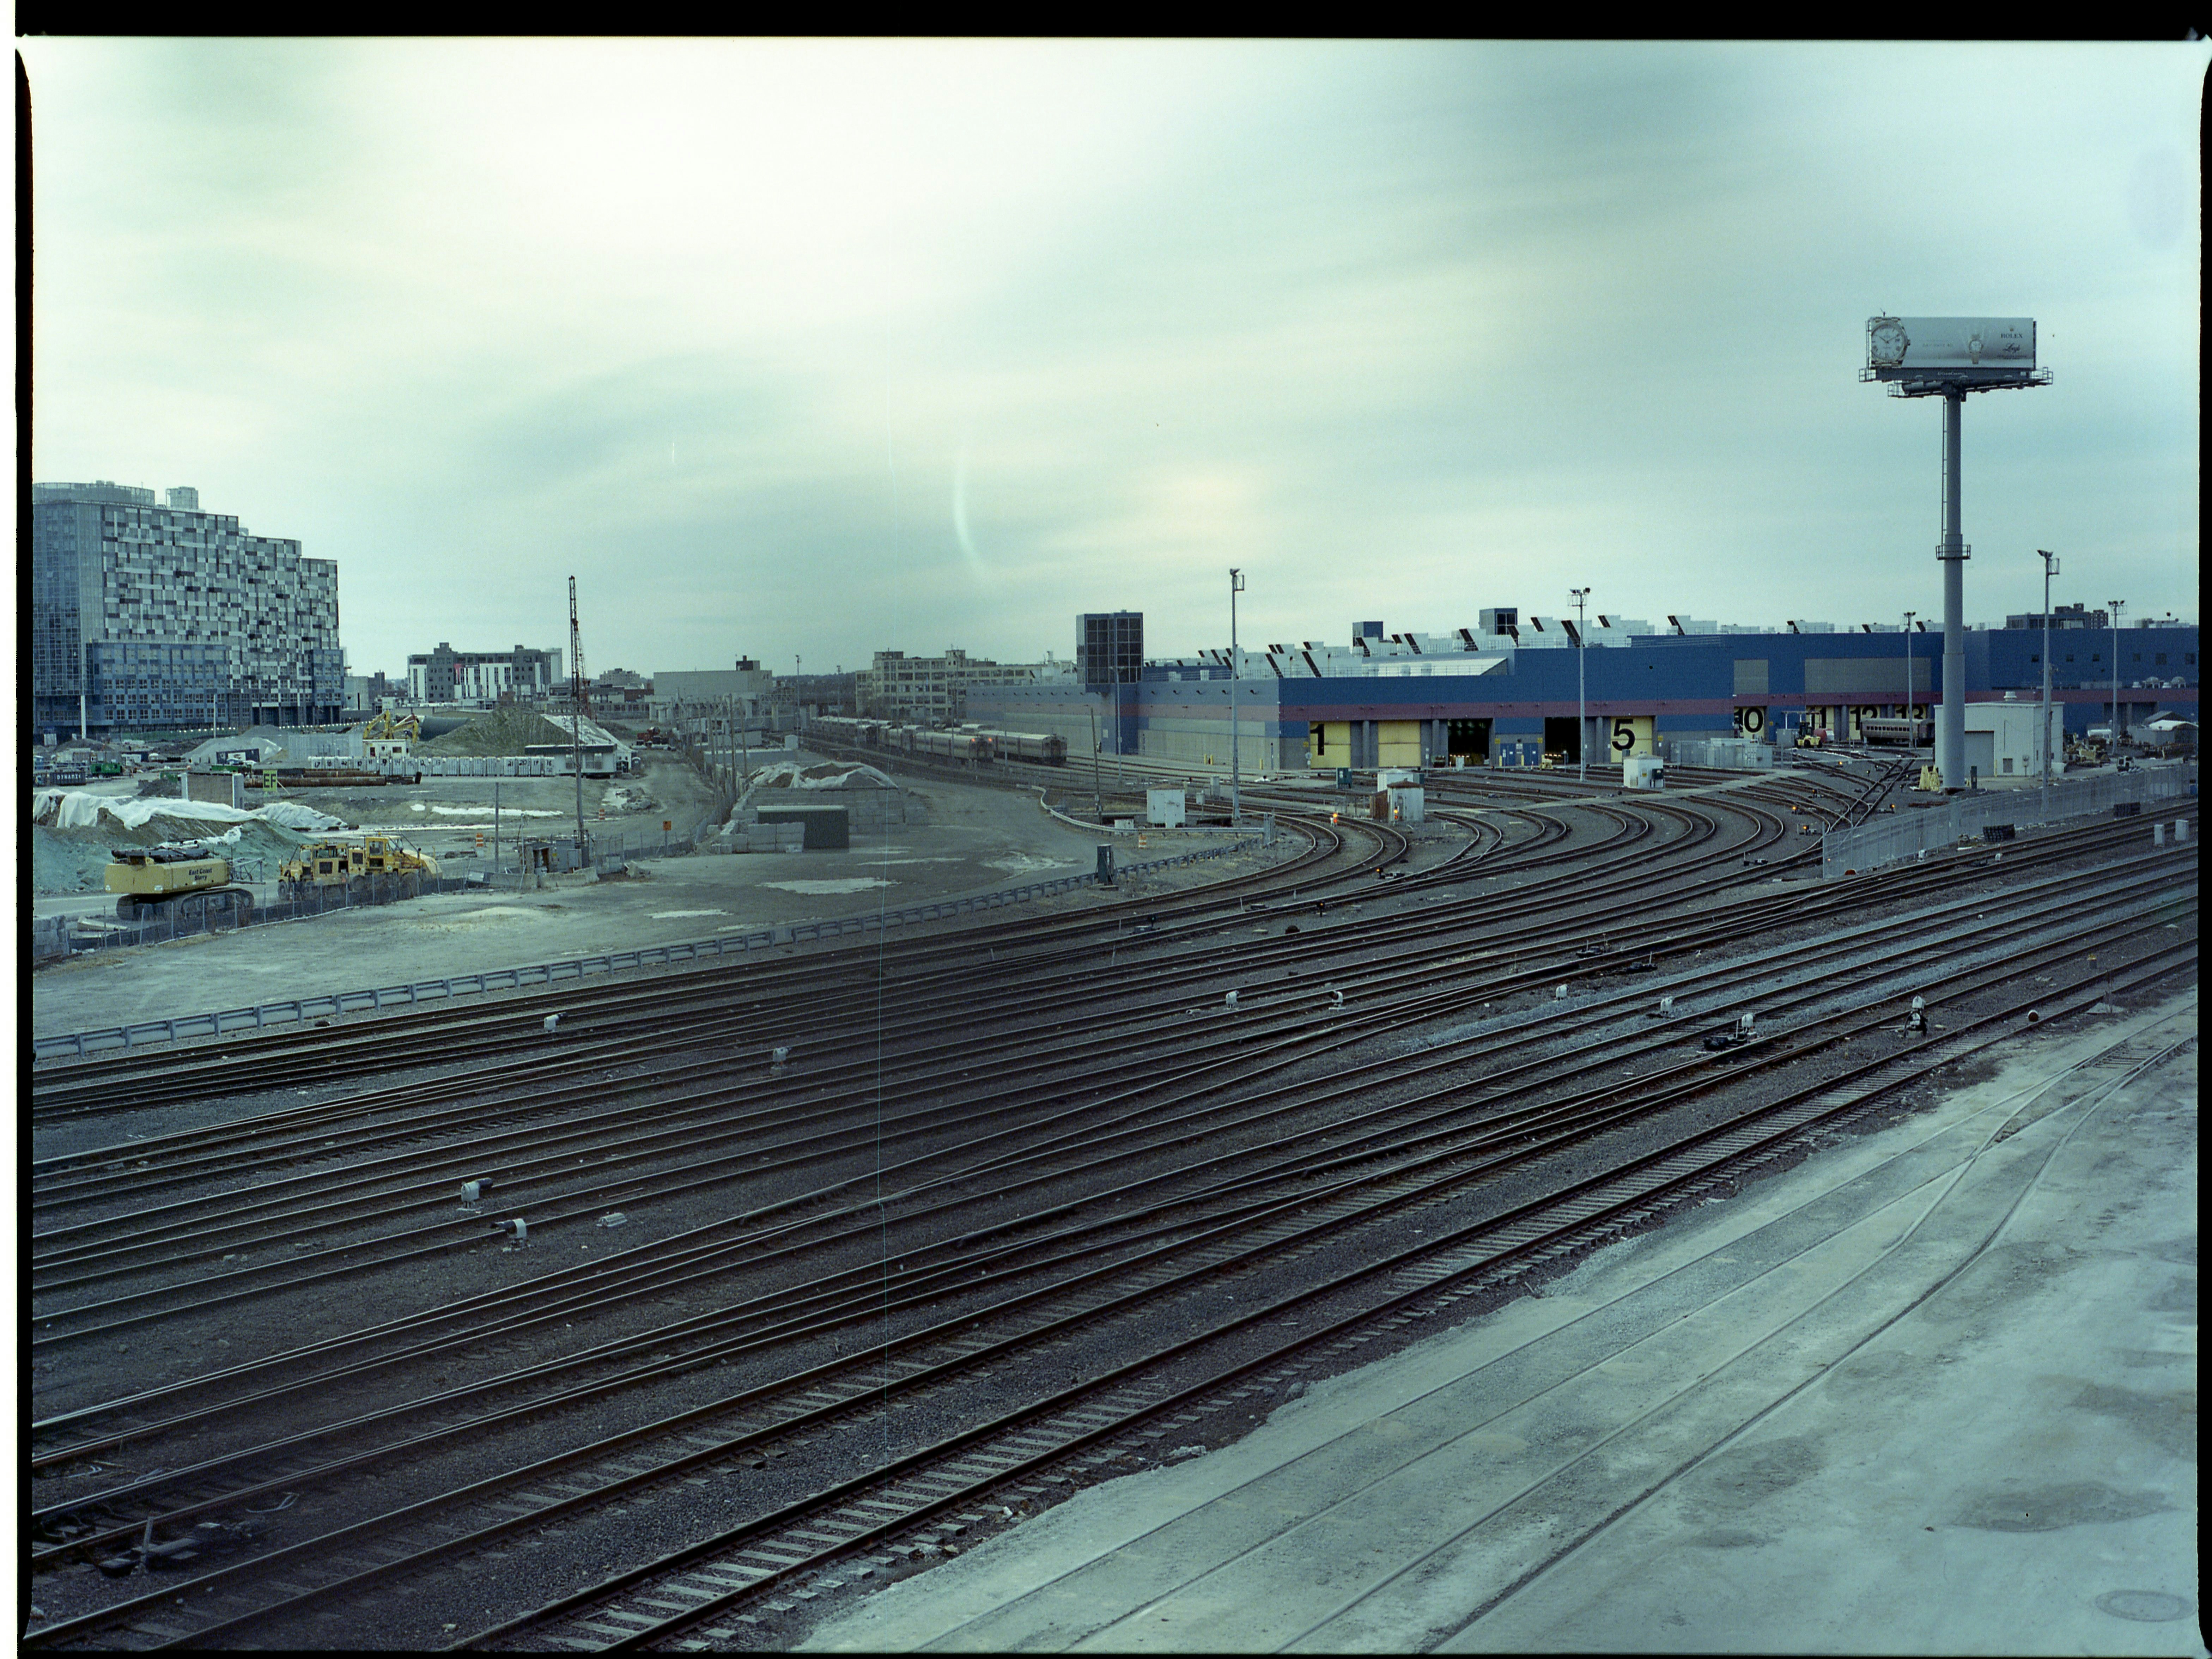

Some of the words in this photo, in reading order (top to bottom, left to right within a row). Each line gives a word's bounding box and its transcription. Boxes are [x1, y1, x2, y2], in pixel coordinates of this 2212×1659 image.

[1734, 707, 1763, 733] 10
[1311, 724, 1325, 756] 1
[1612, 719, 1635, 751] 5
[264, 774, 276, 788] EF
